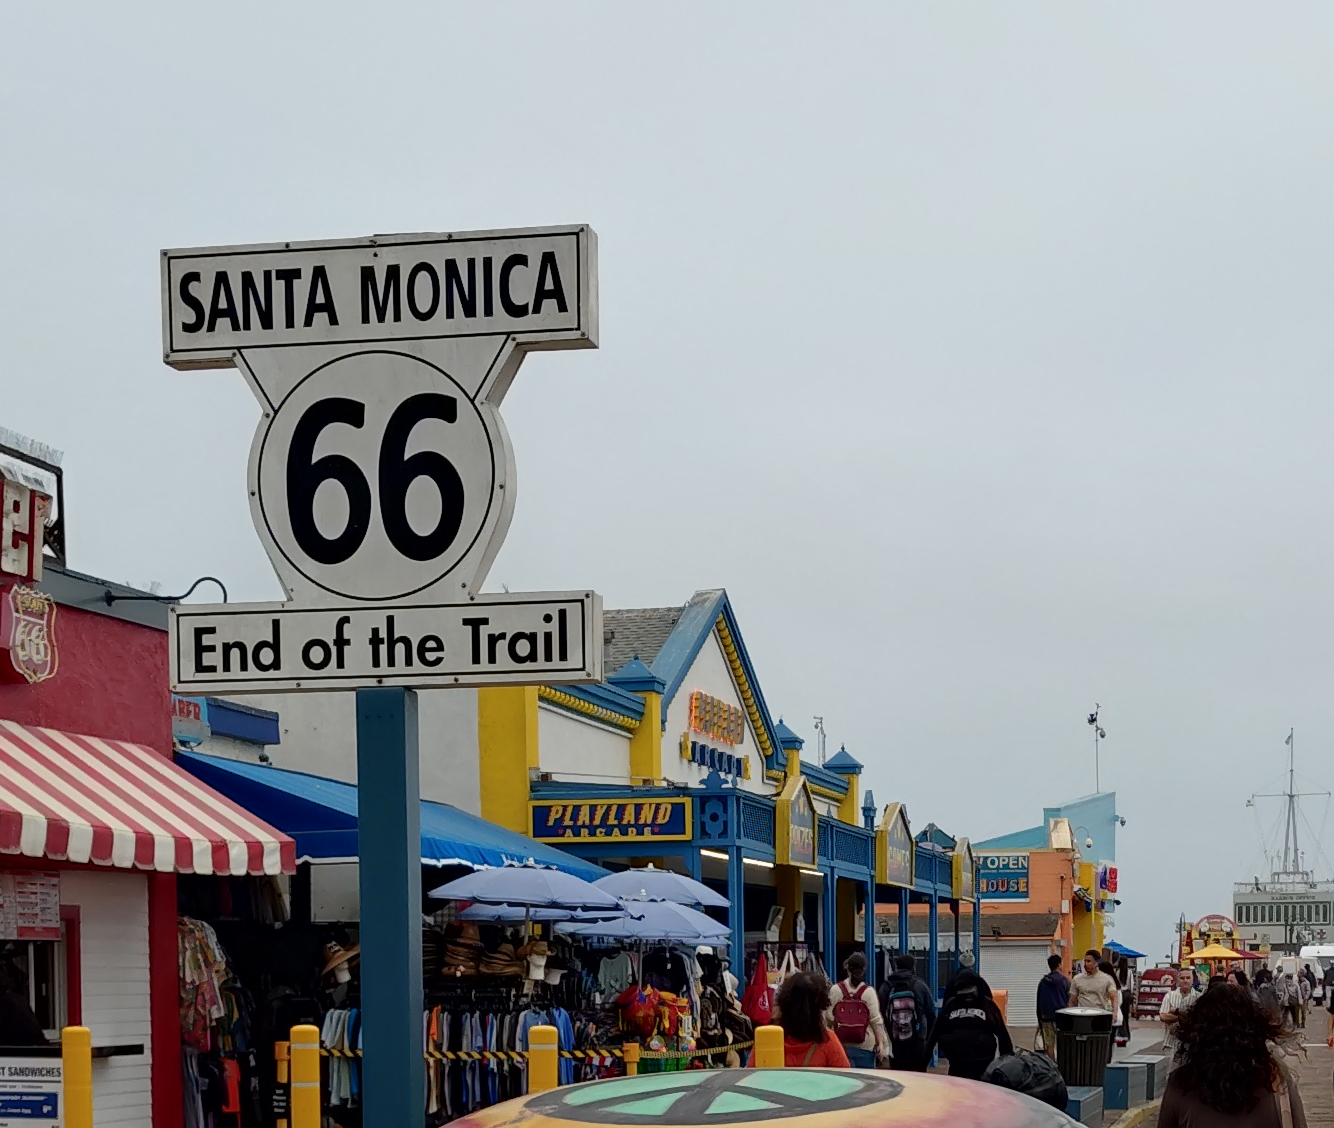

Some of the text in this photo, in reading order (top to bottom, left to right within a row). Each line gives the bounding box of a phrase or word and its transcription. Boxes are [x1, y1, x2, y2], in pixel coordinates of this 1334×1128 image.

[179, 250, 568, 333] SANTA MONICA
[285, 391, 465, 565] 66
[192, 608, 568, 674] End of the Trail
[547, 803, 672, 826] PLAYLAND
[564, 827, 652, 837] ARCADE
[987, 856, 1028, 869] OPEN
[7, 1066, 62, 1077] SANDWICHES
